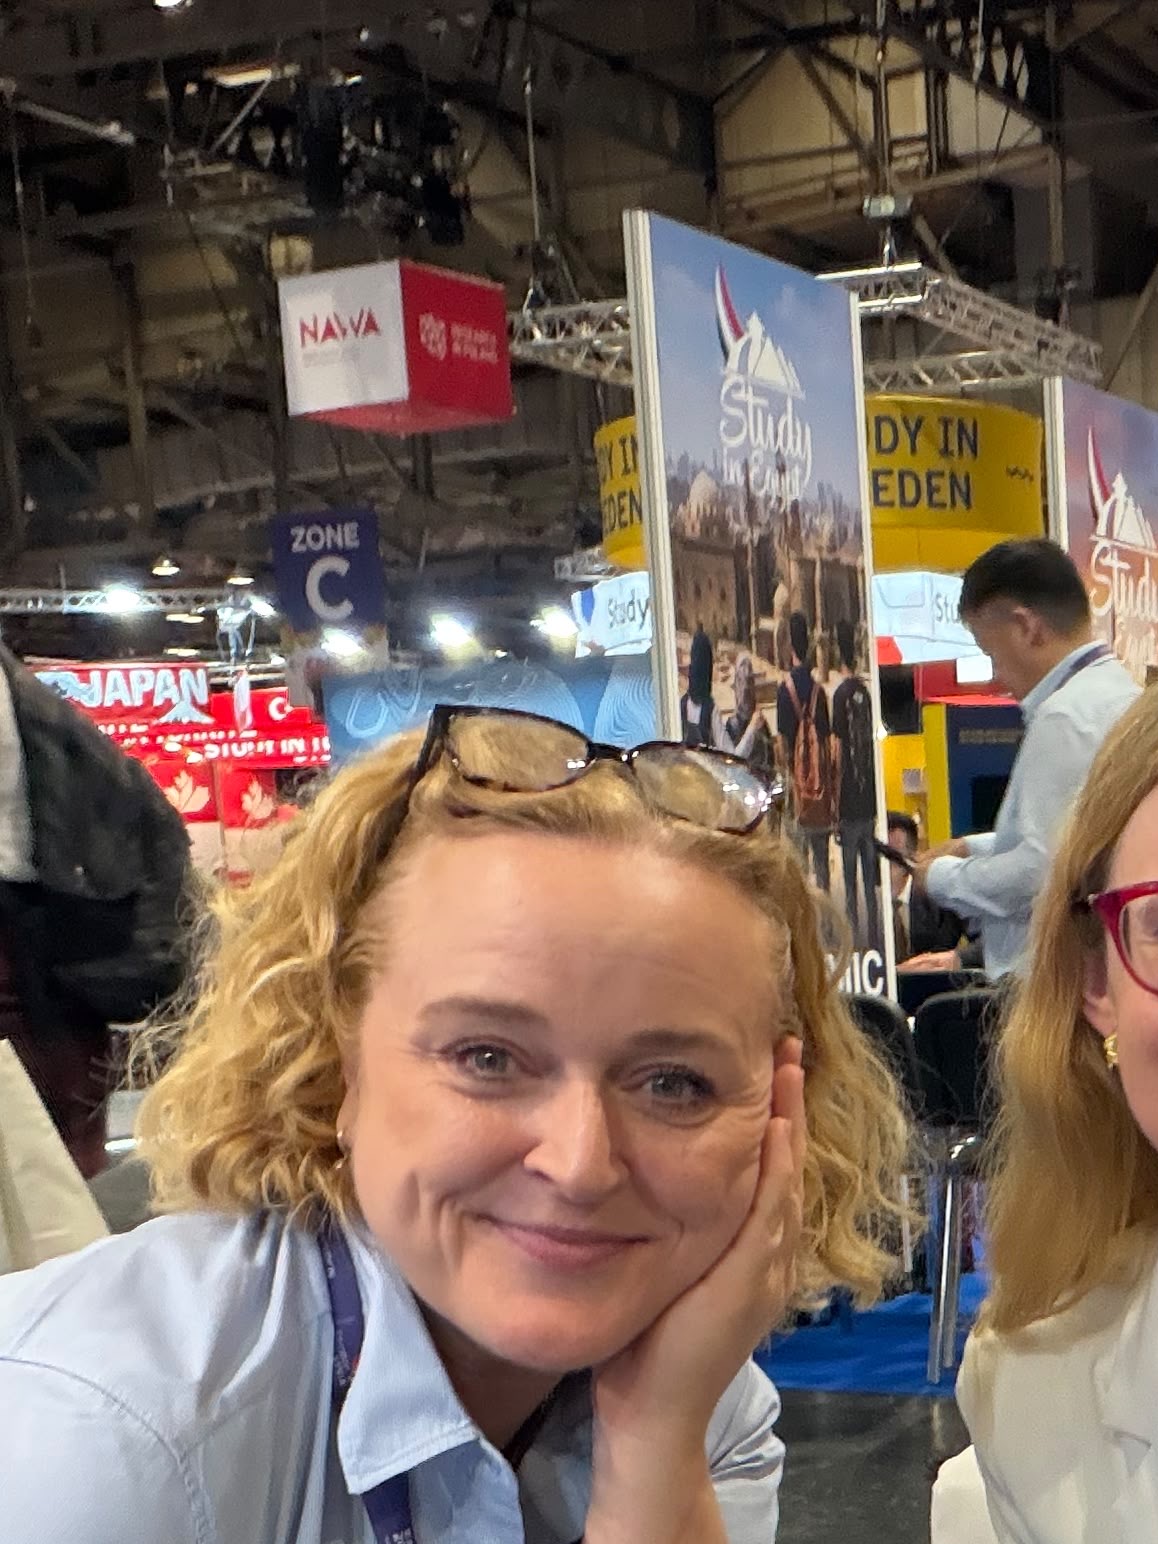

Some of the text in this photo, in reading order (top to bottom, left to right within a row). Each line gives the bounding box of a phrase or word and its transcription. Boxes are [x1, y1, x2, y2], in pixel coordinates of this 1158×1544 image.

[299, 307, 381, 347] NAWA
[720, 375, 812, 489] Study
[867, 414, 978, 460] DY IN
[289, 521, 361, 554] ZONE
[305, 555, 354, 620] C
[80, 668, 209, 709] JAPAN
